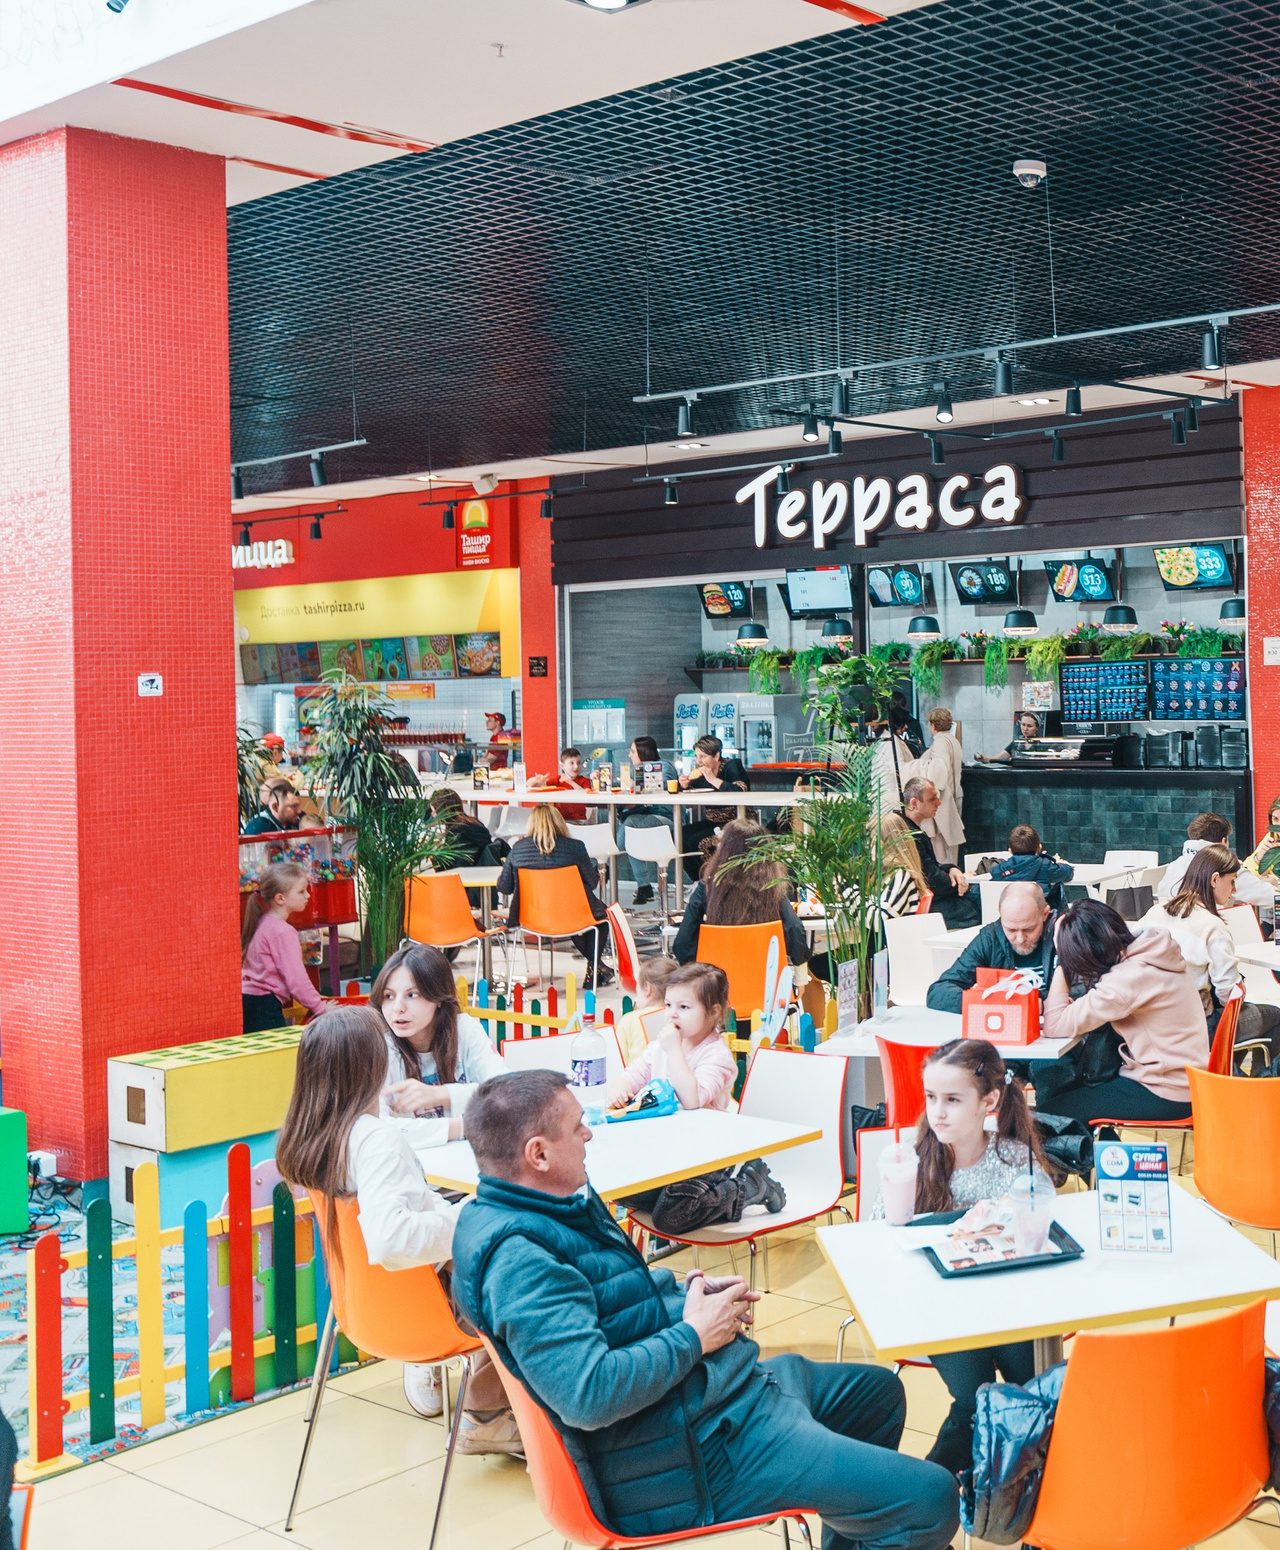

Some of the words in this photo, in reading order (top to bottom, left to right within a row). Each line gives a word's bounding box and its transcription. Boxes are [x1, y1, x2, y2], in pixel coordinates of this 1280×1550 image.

[735, 463, 1026, 549] Терраса
[460, 534, 491, 547] Ташир
[1198, 557, 1221, 570] 333
[901, 579, 913, 590] 90
[987, 573, 1006, 585] 188
[1083, 574, 1102, 586] 313
[727, 590, 743, 601] 120
[303, 600, 365, 616] tashirpizza.ru
[1132, 1152, 1163, 1162] СУПЕР
[1139, 1161, 1162, 1171] ЦЕНА!
